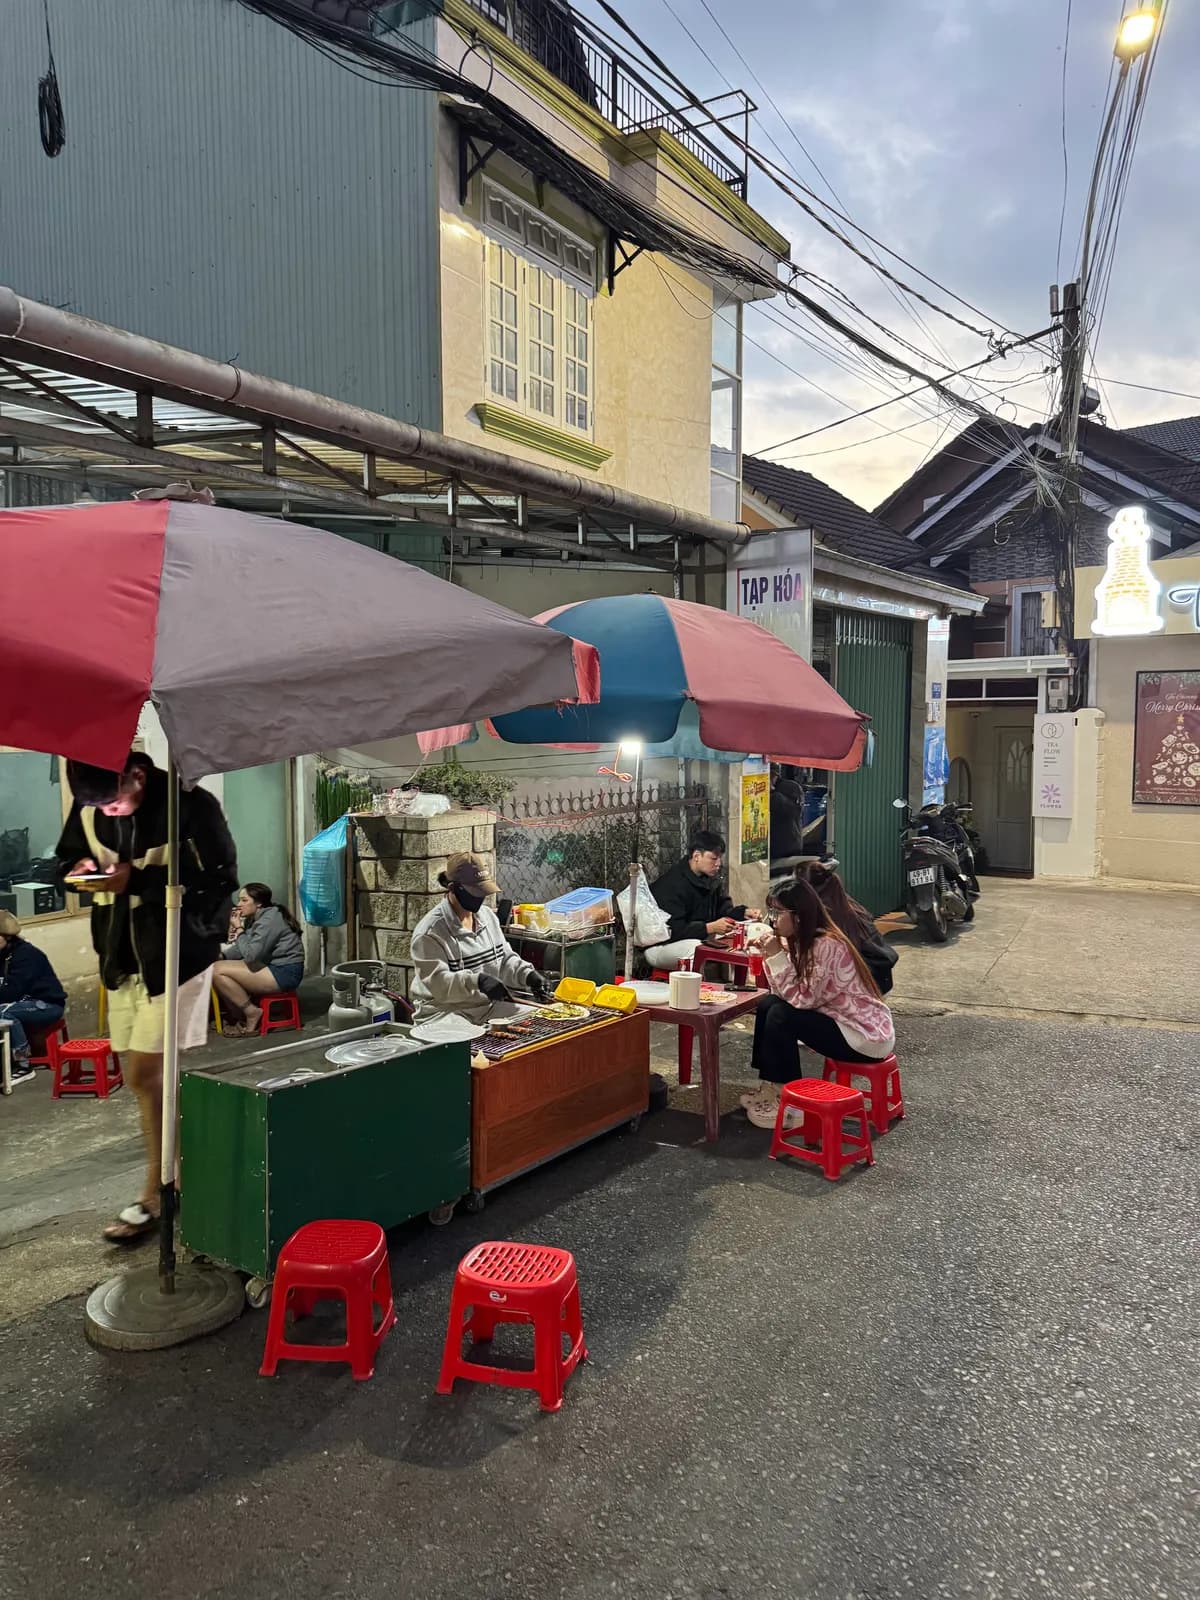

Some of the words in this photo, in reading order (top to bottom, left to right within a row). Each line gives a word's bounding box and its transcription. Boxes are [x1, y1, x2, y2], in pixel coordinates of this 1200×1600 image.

[741, 576, 769, 611] TẠP
[773, 567, 803, 602] HÓA
[1145, 700, 1174, 715] Merry
